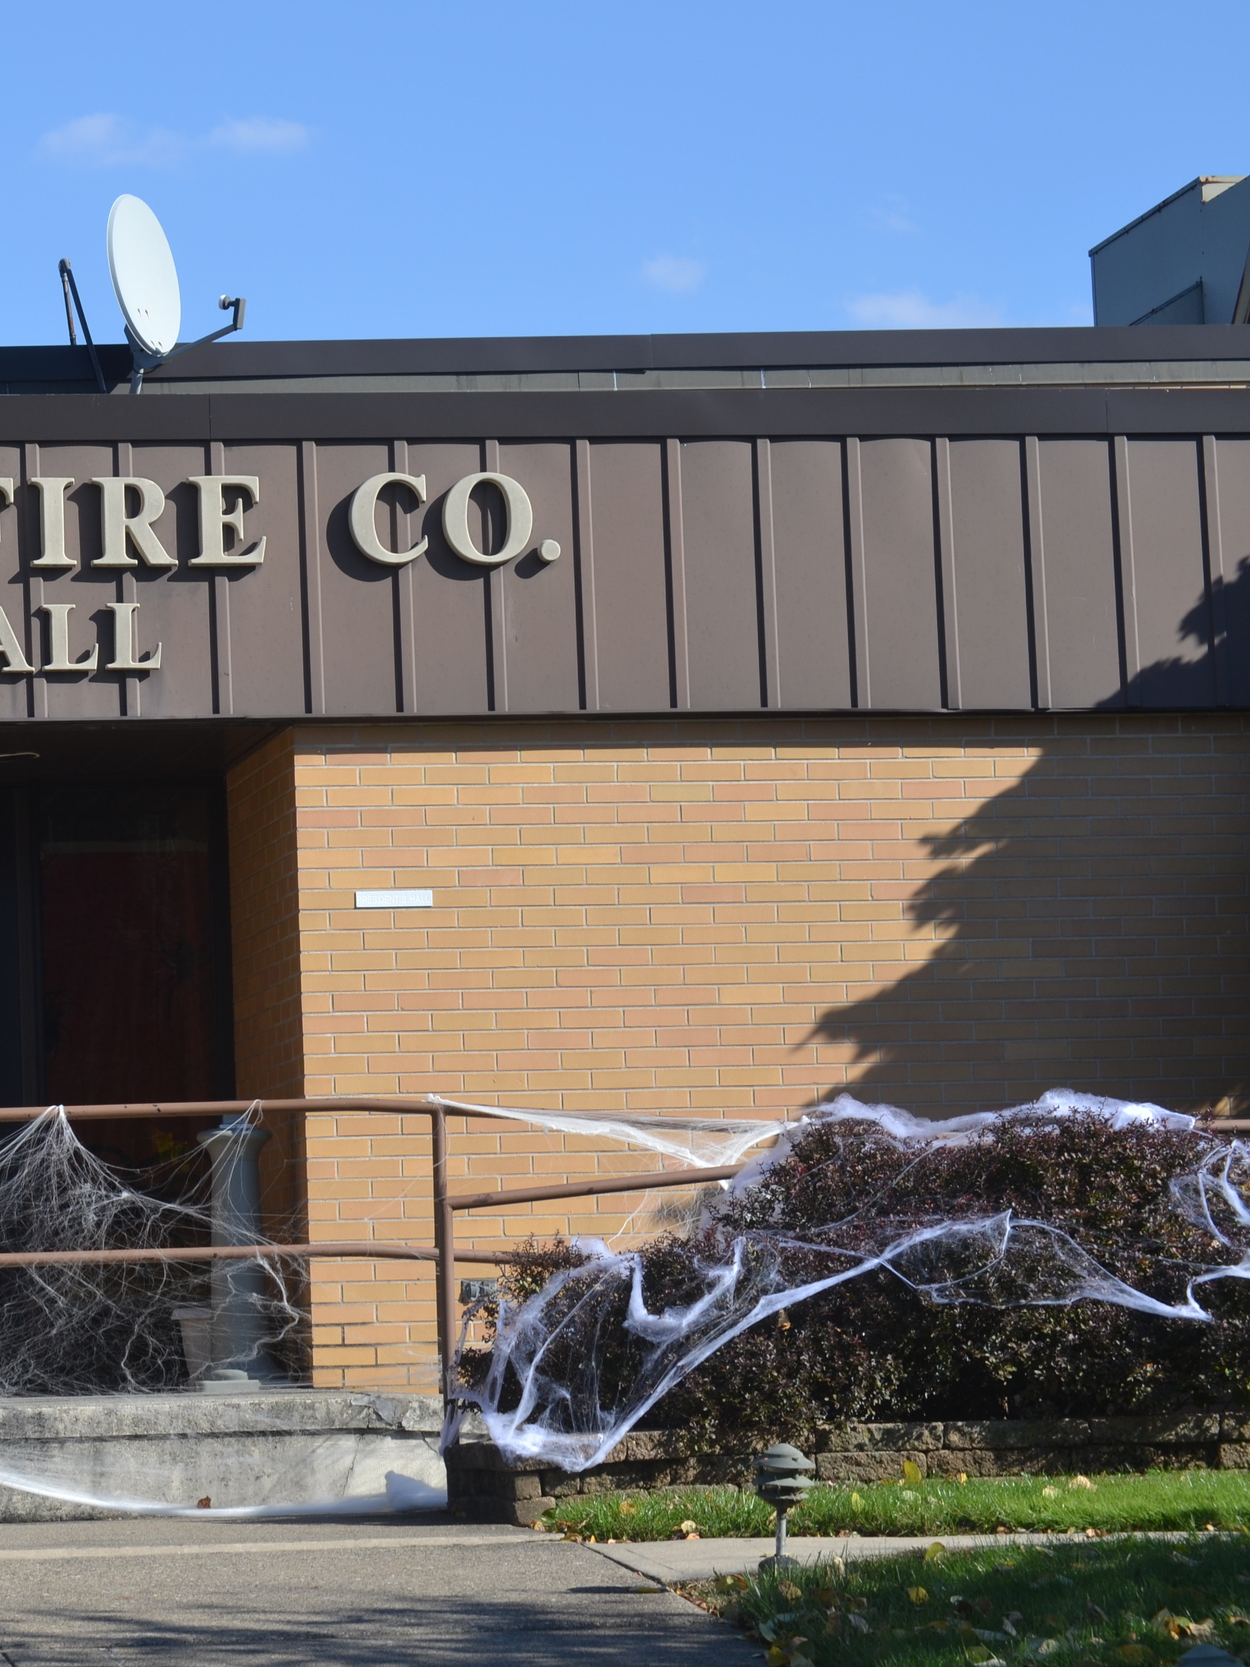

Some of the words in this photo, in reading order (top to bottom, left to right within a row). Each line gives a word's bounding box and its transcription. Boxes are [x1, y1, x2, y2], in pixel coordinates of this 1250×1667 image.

[348, 471, 561, 566] CO.
[357, 895, 407, 905] PRESIDENT'S
[409, 894, 430, 904] HALL
